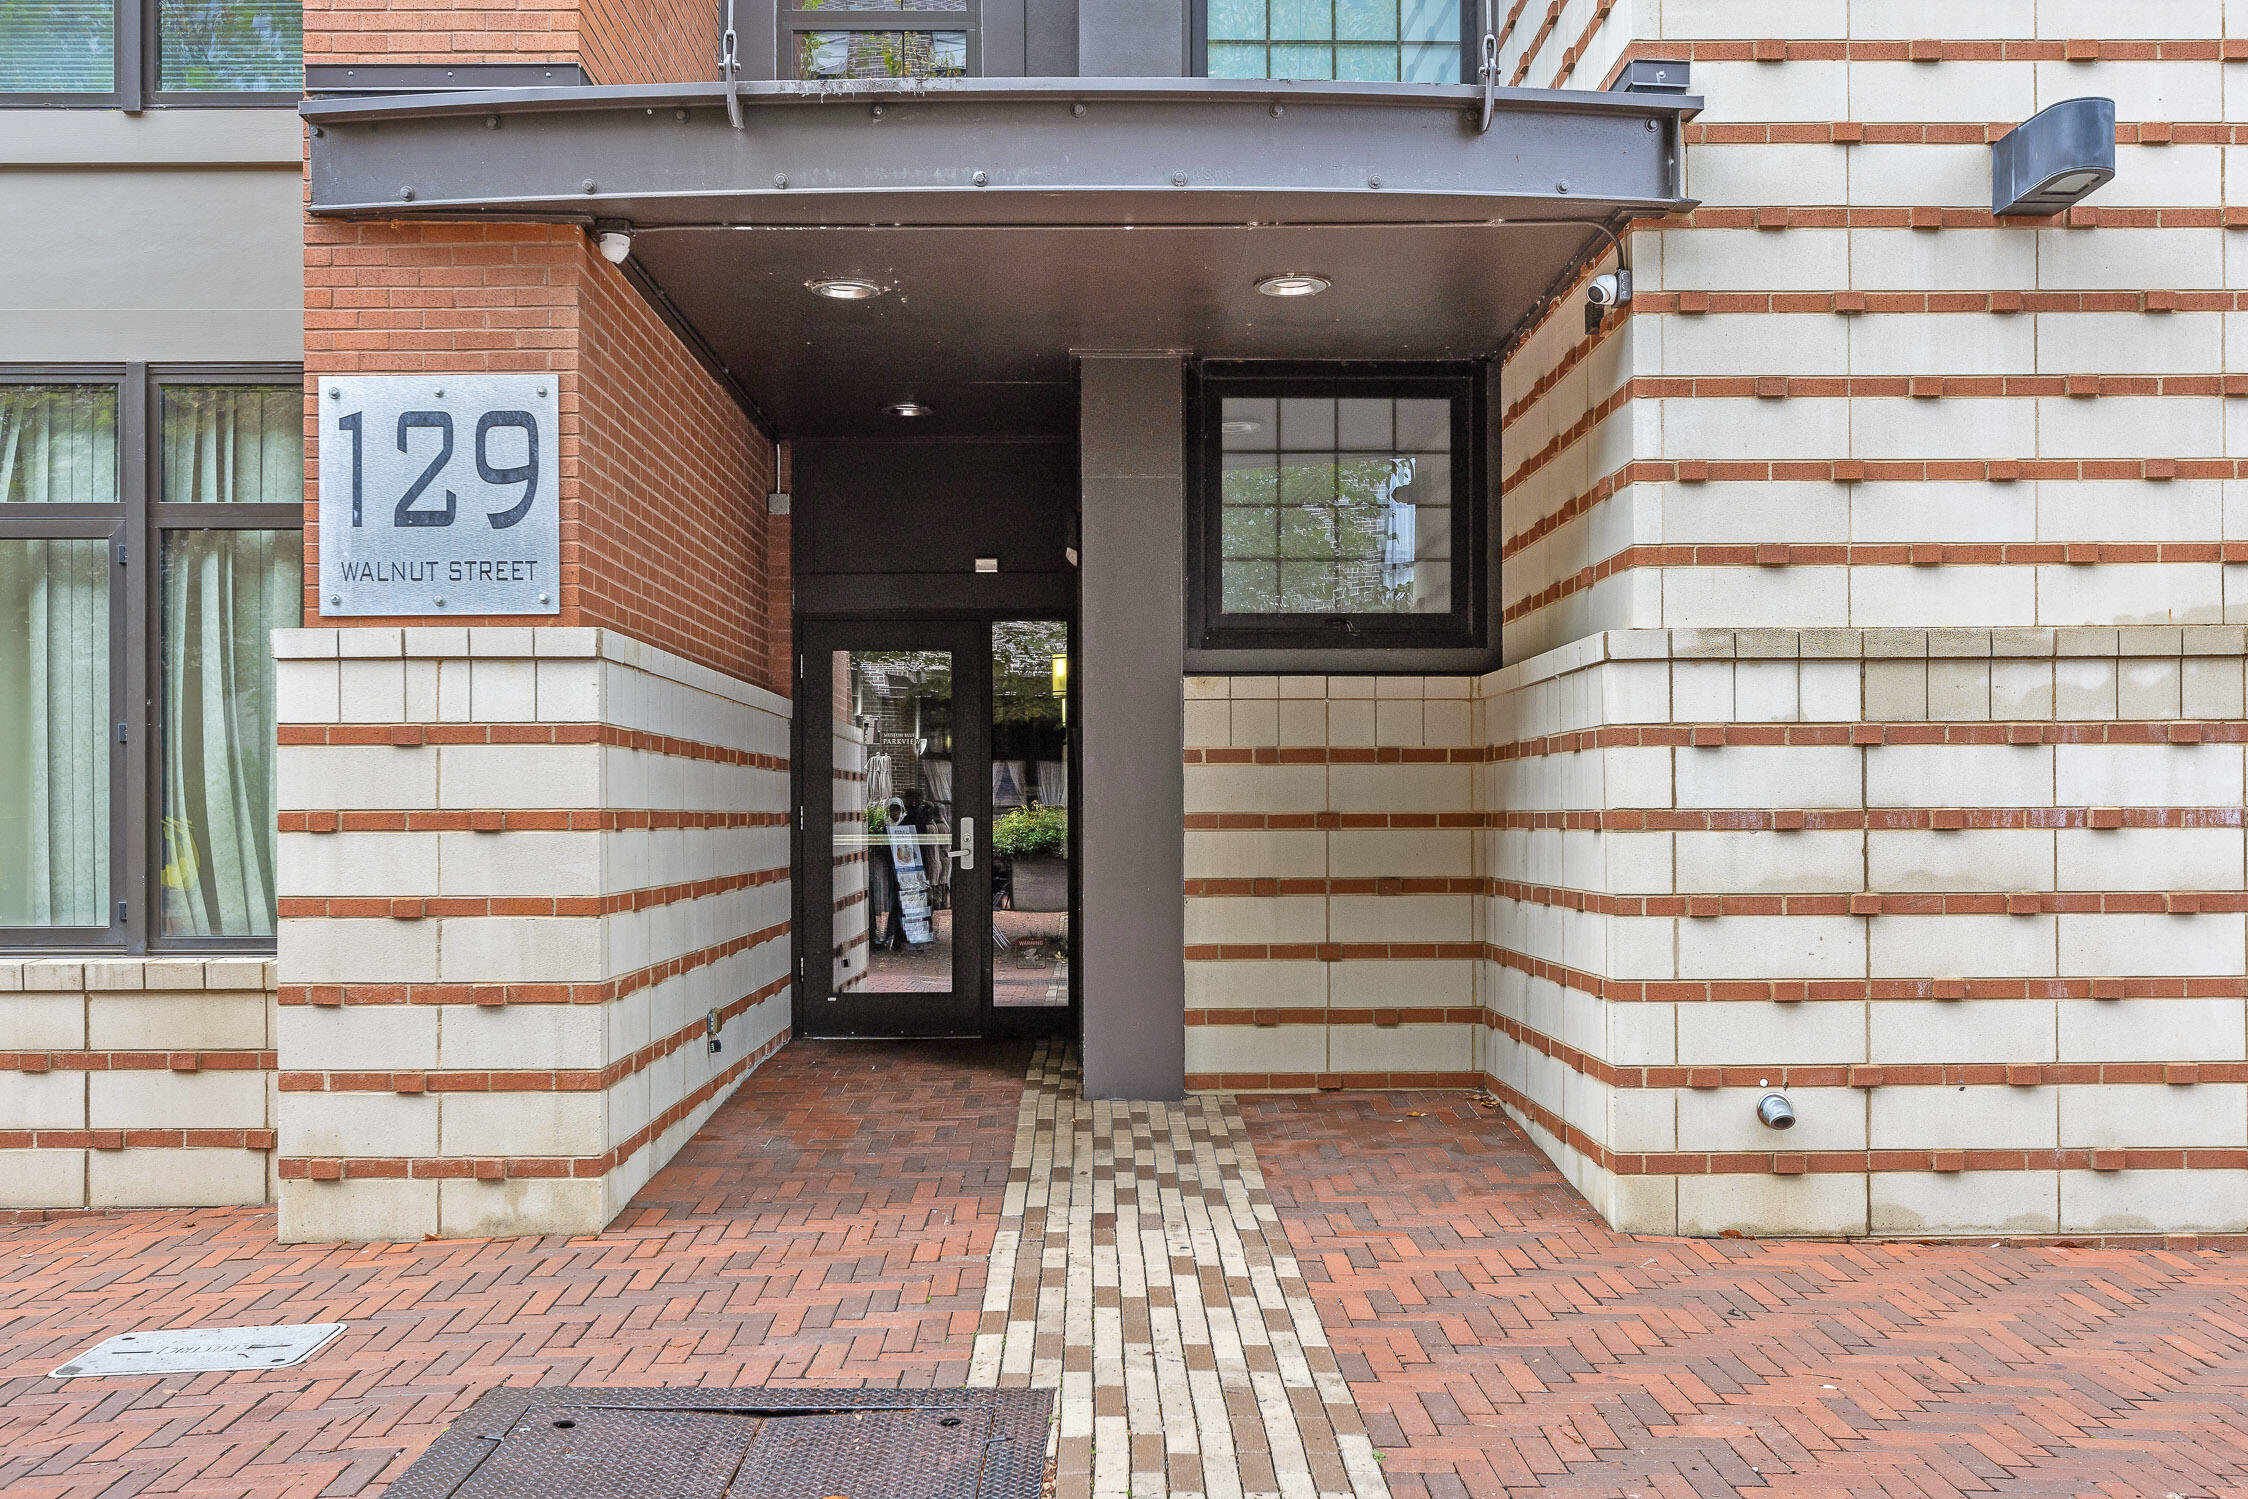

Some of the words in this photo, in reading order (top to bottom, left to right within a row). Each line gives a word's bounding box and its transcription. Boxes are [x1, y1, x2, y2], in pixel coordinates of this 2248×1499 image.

[338, 410, 540, 530] 129
[340, 561, 439, 582] WALNUT
[448, 560, 538, 582] STREET
